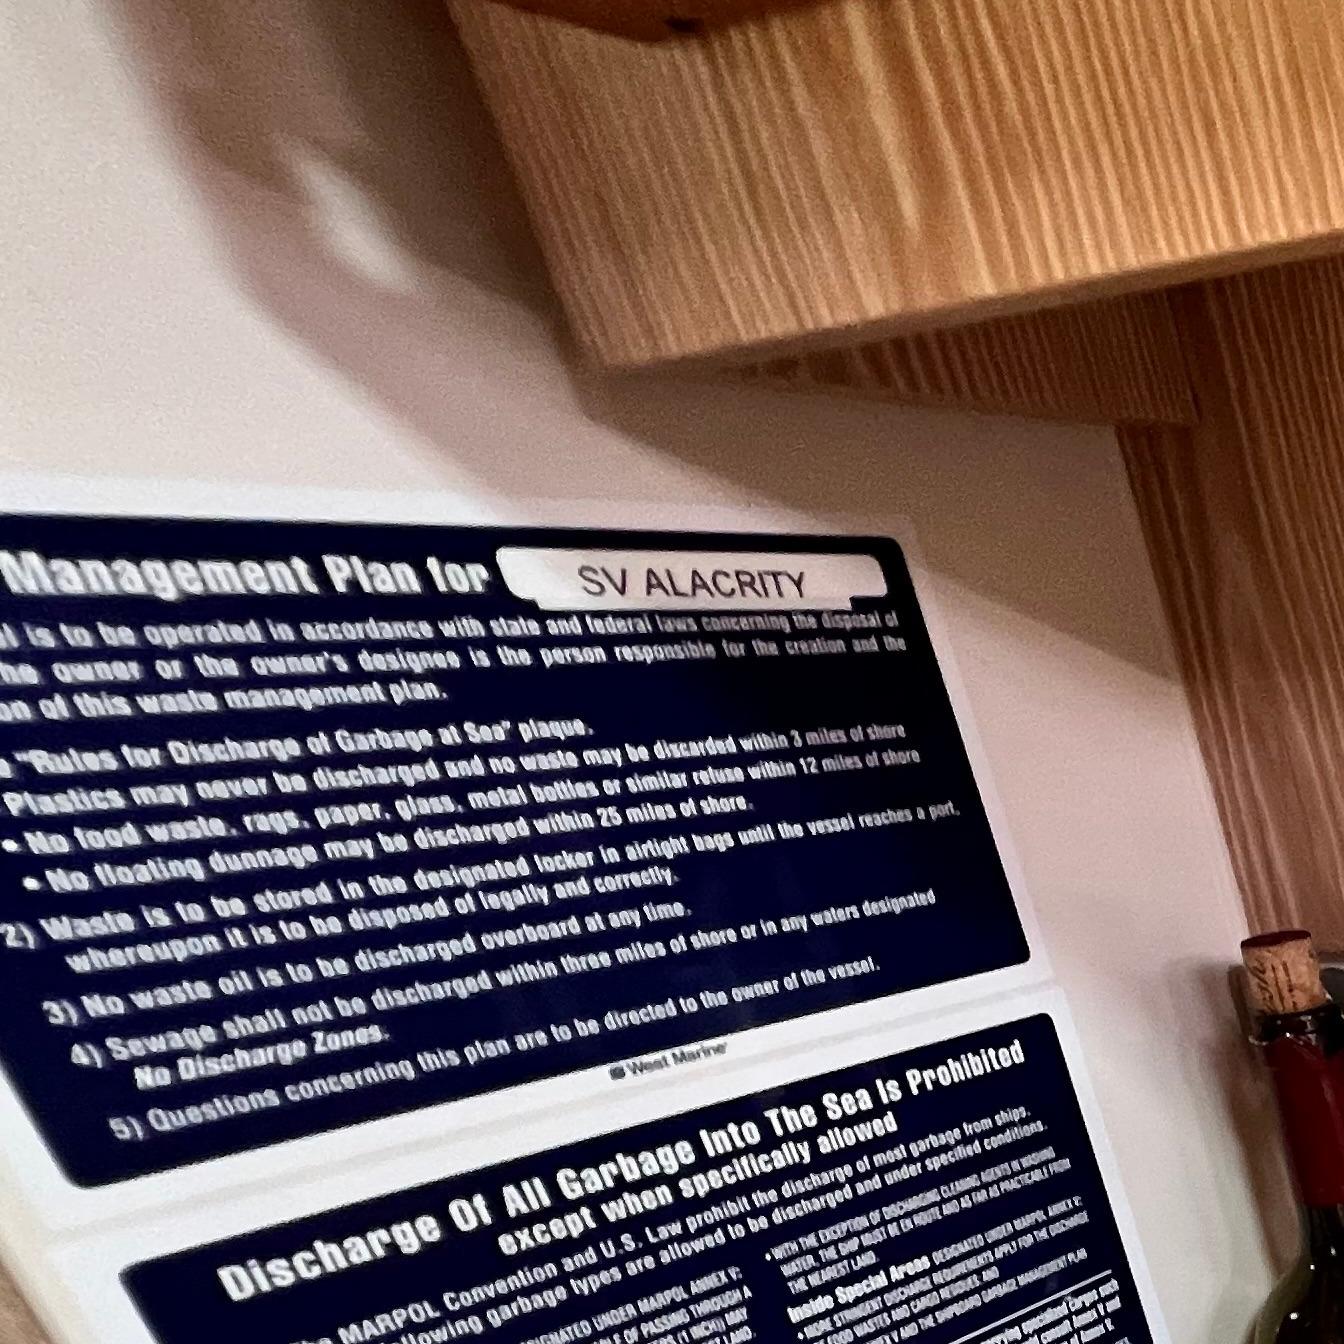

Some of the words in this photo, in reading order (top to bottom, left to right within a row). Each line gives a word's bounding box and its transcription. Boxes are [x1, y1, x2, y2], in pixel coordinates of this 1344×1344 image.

[0, 551, 320, 601] Management
[322, 554, 423, 593] Plan
[427, 556, 490, 594] for
[577, 564, 627, 598] SV
[645, 567, 806, 599] ALACRITY
[1, 788, 127, 816] Plastics
[128, 783, 190, 807] may
[195, 777, 268, 799] never
[271, 771, 308, 793] be
[312, 757, 441, 790] discharged
[443, 753, 485, 778] and
[487, 755, 516, 774] no
[518, 749, 579, 771] waste
[581, 747, 622, 767] may
[623, 742, 650, 762] be
[652, 734, 737, 759] discarded
[738, 732, 789, 751] within
[789, 729, 803, 747] 3
[805, 727, 847, 745] miles
[849, 724, 864, 742] of
[865, 724, 906, 740] shore
[13, 748, 119, 774] "Rules
[120, 743, 162, 768] for
[166, 736, 302, 765] Discharge
[305, 730, 332, 755] of
[333, 727, 434, 752] Garbage
[437, 724, 462, 745] at
[462, 719, 511, 743] Sea"
[44, 867, 91, 893] No
[93, 857, 206, 886] floating
[207, 844, 319, 873] dunnage
[322, 837, 374, 859] may
[375, 831, 409, 853] be
[412, 815, 530, 849] discharged
[532, 810, 595, 834] within
[595, 805, 622, 827] 25
[624, 802, 677, 823] miles
[678, 796, 698, 817] of
[41, 999, 79, 1026] 3)
[79, 993, 125, 1017] No
[128, 980, 213, 1009] waste
[217, 969, 254, 995] oil
[256, 967, 284, 987] is
[284, 962, 313, 983] to
[314, 957, 349, 977] be
[353, 932, 477, 971] discharged
[480, 914, 581, 949] overboard
[584, 911, 606, 932] at
[607, 909, 641, 928] any
[64, 934, 223, 973] whereupon
[223, 926, 248, 948] it
[248, 923, 277, 945] is
[278, 919, 307, 940] to
[308, 914, 343, 936] be
[347, 895, 450, 930] disposed
[453, 891, 476, 914] of
[477, 882, 549, 911] legally
[552, 875, 591, 899] and
[108, 1115, 144, 1140] 5)
[146, 1088, 280, 1131] Questions
[284, 1059, 415, 1101] concerning
[416, 1048, 461, 1071] this
[463, 1038, 511, 1065] plan
[514, 1029, 548, 1051] are
[549, 1023, 572, 1042] to
[572, 1018, 600, 1037] be
[603, 997, 677, 1030] directed
[678, 996, 698, 1013] to
[698, 990, 728, 1009] the
[730, 979, 779, 1002] owner
[782, 971, 799, 990] of
[799, 968, 826, 986] the
[133, 1065, 171, 1089] No
[176, 1039, 307, 1080] Discharge
[626, 1054, 671, 1075] West
[672, 1043, 727, 1065] Marine
[216, 1214, 441, 1301] Discharge
[447, 1192, 492, 1232] Of
[501, 1176, 551, 1218] All
[555, 1139, 696, 1200] Garbage
[698, 1120, 761, 1157] Into
[765, 1103, 818, 1137] The
[821, 1087, 873, 1120] Sea
[874, 1078, 902, 1104] Is
[904, 1038, 1025, 1095] Prohibited
[442, 1262, 558, 1311] Convention
[560, 1245, 598, 1272] and
[644, 1220, 682, 1243] Law
[684, 1195, 751, 1233] prohibit
[750, 1188, 778, 1208] the
[780, 1163, 853, 1198] discharge
[855, 1154, 871, 1173] of
[872, 1143, 907, 1167] most
[908, 1127, 961, 1157] garbage
[961, 1117, 993, 1136] from
[497, 1205, 597, 1255] except
[600, 1183, 673, 1222] when
[677, 1140, 811, 1198] specifically
[816, 1110, 898, 1154] allowed
[485, 1285, 567, 1328] garbage
[569, 1266, 622, 1295] types
[624, 1254, 656, 1276] are
[658, 1226, 726, 1264] allowed
[726, 1222, 745, 1240] to
[746, 1215, 769, 1232] be
[771, 1182, 853, 1224] discharged
[854, 1173, 882, 1195] and
[883, 1161, 922, 1185] under
[924, 1139, 982, 1171] specified
